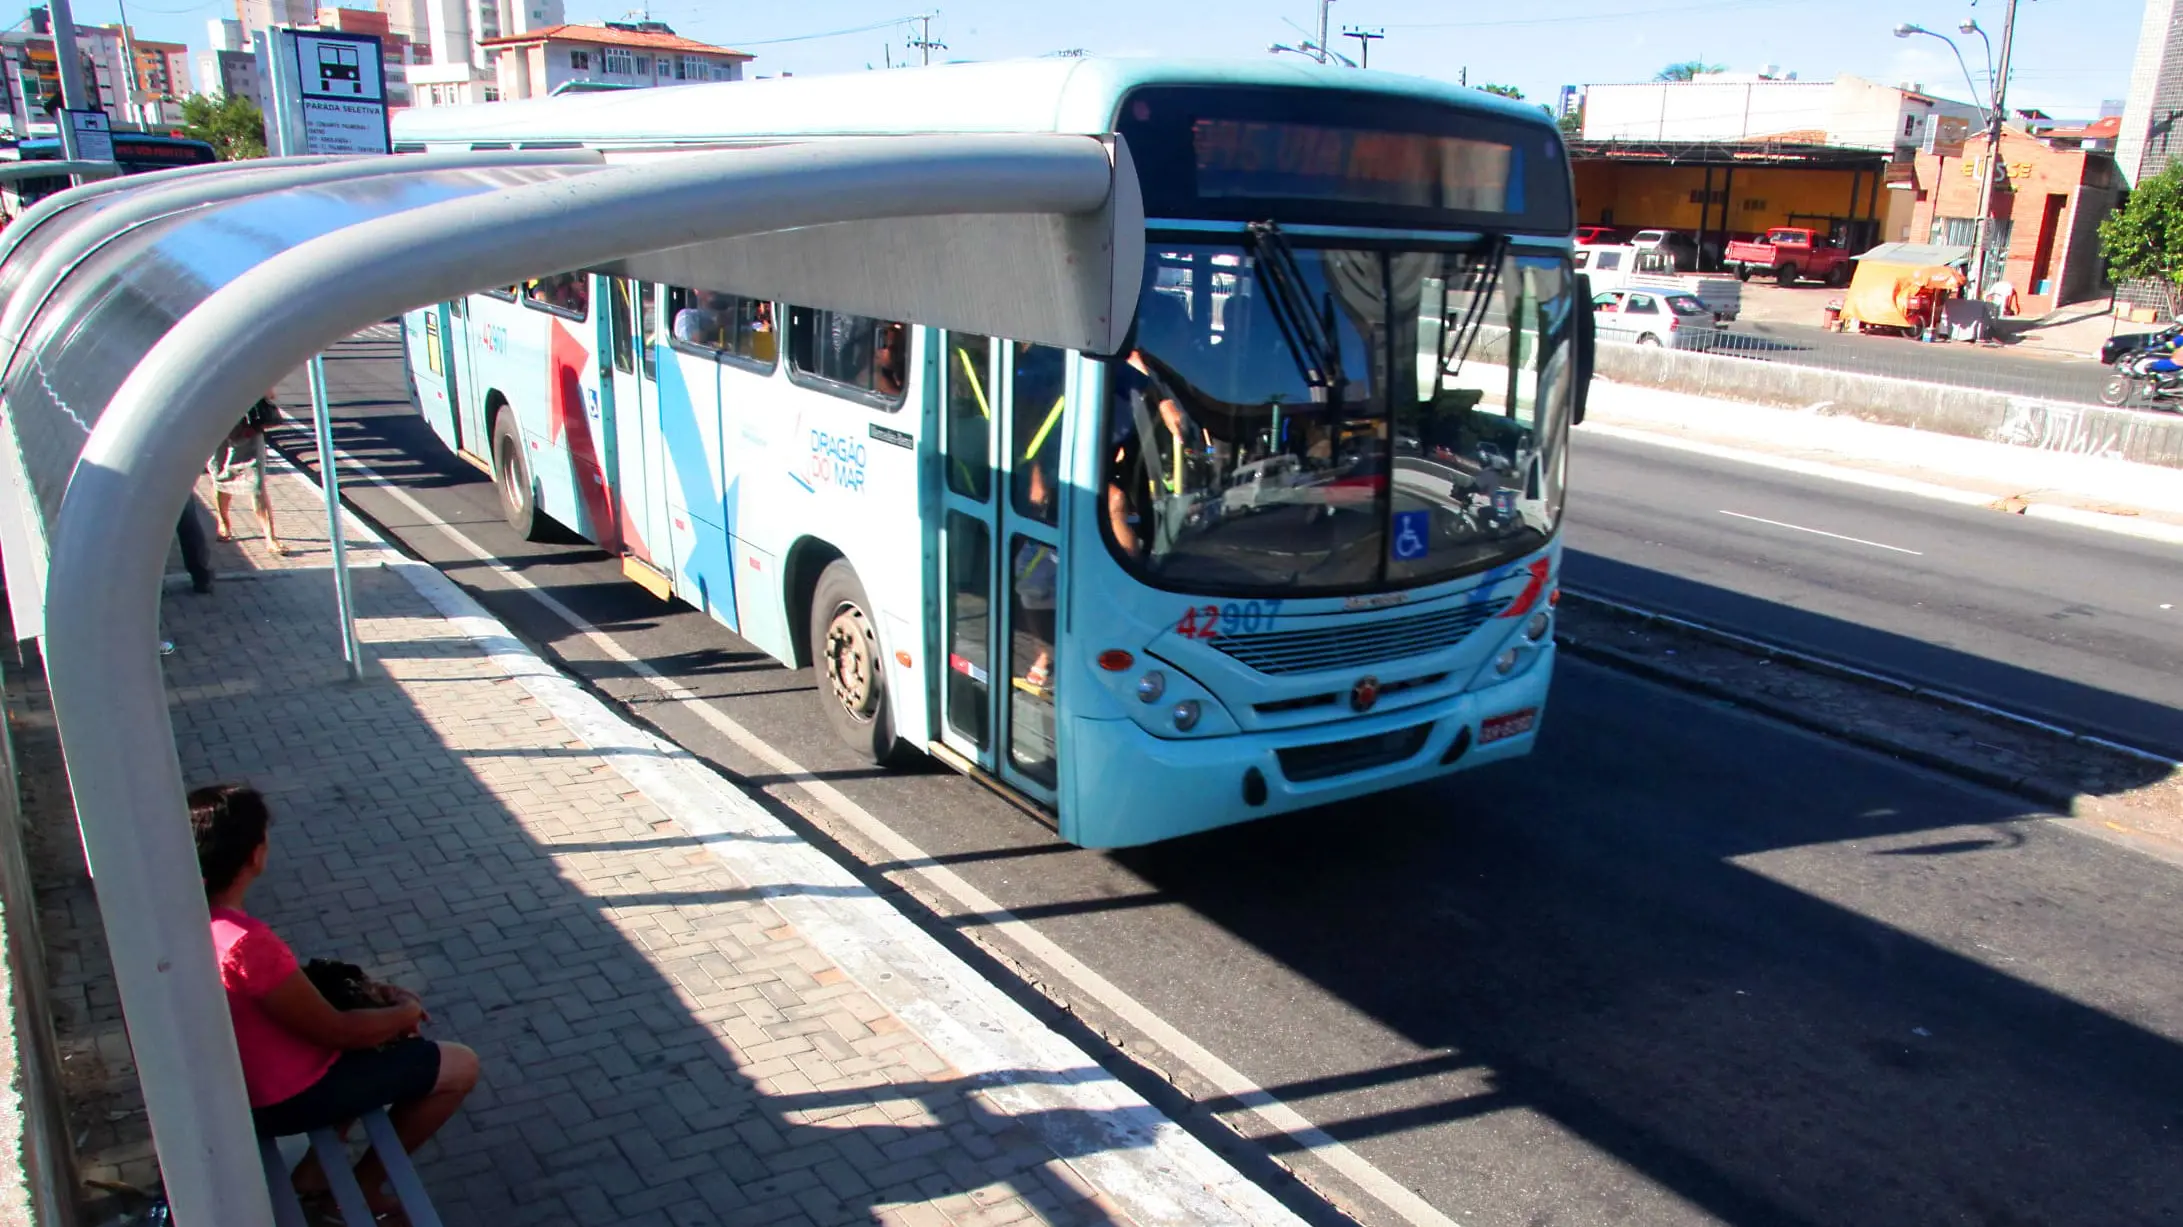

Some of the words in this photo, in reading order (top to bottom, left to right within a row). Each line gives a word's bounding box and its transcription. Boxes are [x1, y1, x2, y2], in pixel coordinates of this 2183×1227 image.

[305, 102, 340, 112] PARADA
[343, 104, 381, 115] SELETIVA
[483, 324, 507, 357] 42907
[811, 430, 866, 468] DRAGÃO
[812, 455, 830, 481] DO
[834, 462, 866, 495] MAR
[1175, 599, 1282, 639] 42907
